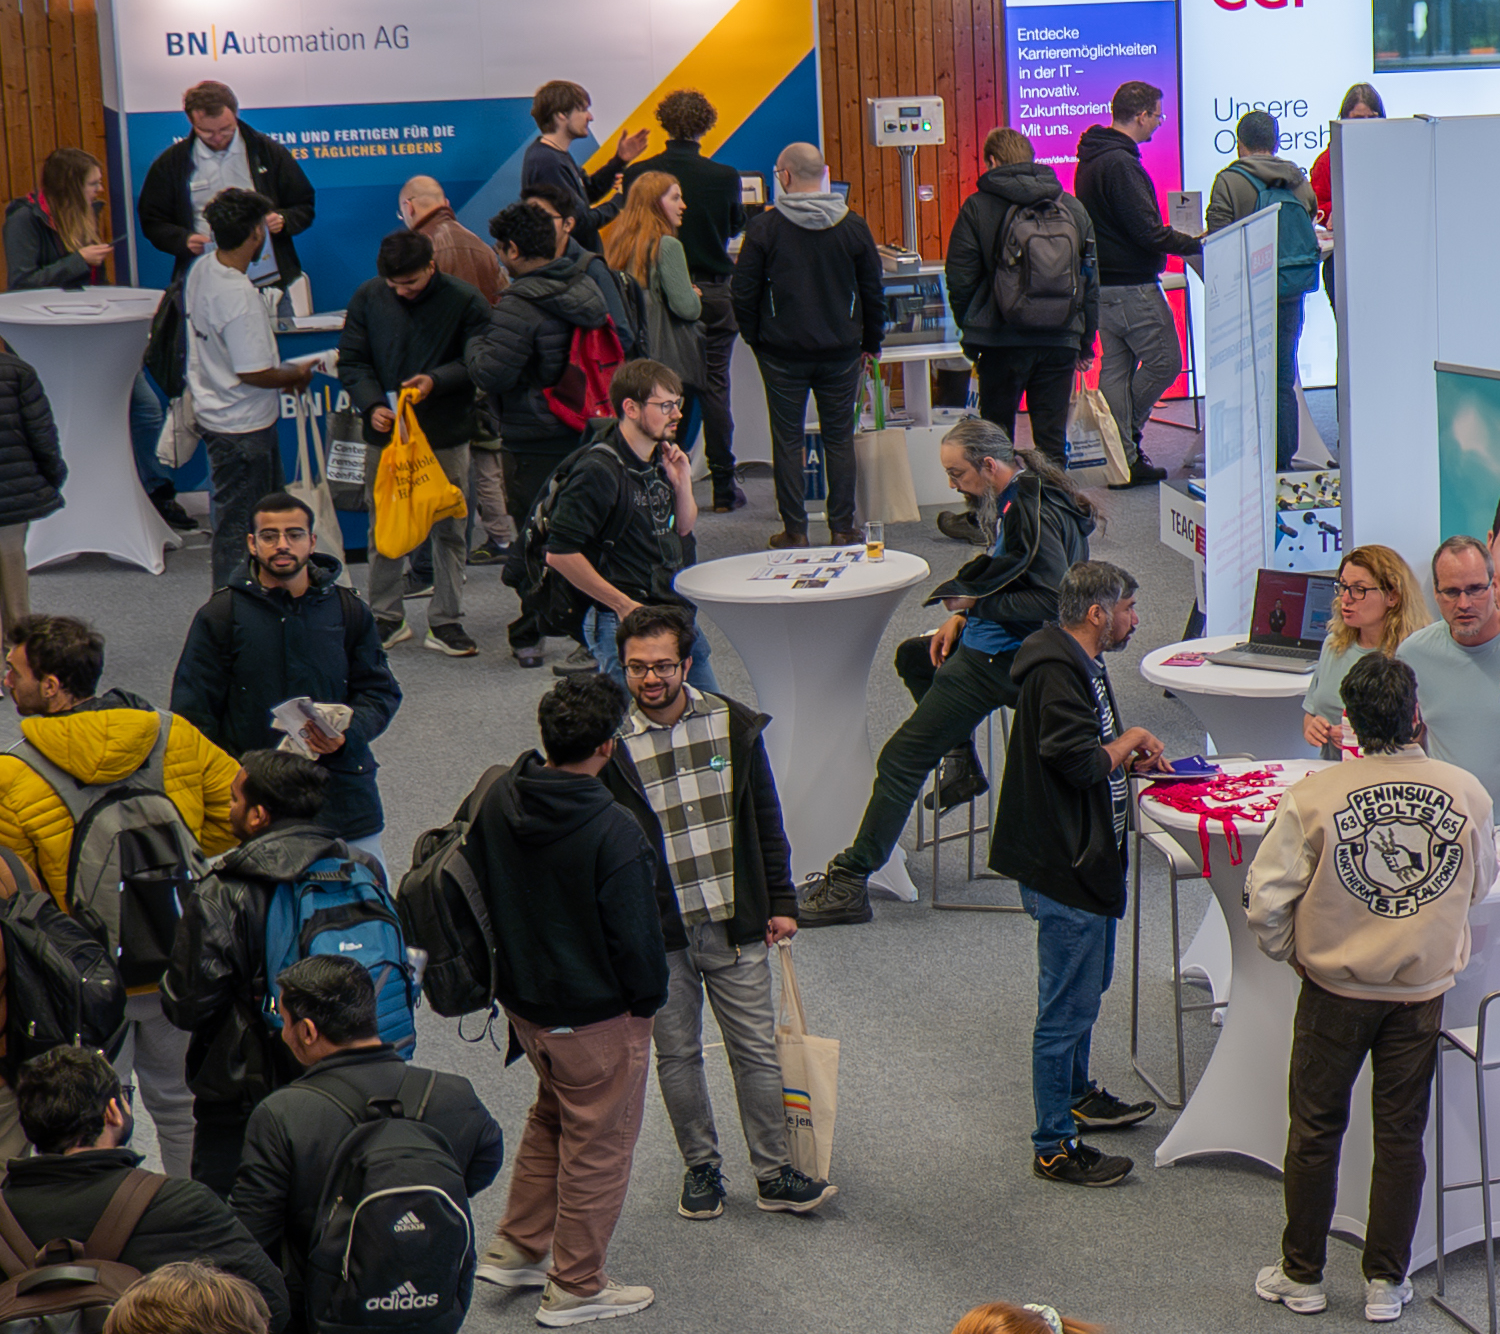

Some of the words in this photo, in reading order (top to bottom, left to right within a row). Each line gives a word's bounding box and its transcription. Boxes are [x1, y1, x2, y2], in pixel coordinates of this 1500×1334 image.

[374, 24, 409, 50] AG
[1017, 27, 1080, 42] Entdecke
[1018, 43, 1157, 61] Karrieremöglichkeiten
[1020, 85, 1080, 99] Innovativ.
[1020, 101, 1112, 118] Zukunftsorient
[301, 131, 330, 145] UND
[334, 128, 399, 143] FERTIGEN
[403, 125, 430, 139] FÜR
[433, 125, 456, 138] DIE
[1021, 124, 1041, 137] Mit
[1045, 123, 1073, 136] uns.
[314, 145, 387, 160] TÄGLICHEN
[391, 142, 442, 157] LEBENS
[1171, 508, 1195, 543] TEAG
[1353, 786, 1446, 811] PENINSULA
[1363, 802, 1436, 824] BOLTS
[1340, 815, 1358, 831] 63
[1441, 817, 1458, 835] 65
[1338, 847, 1373, 900] NORTHERN
[1415, 847, 1461, 901] CALIFORNIA
[1375, 898, 1415, 916] S.F.
[394, 1221, 425, 1233] adidas
[366, 1292, 439, 1311] adidas
